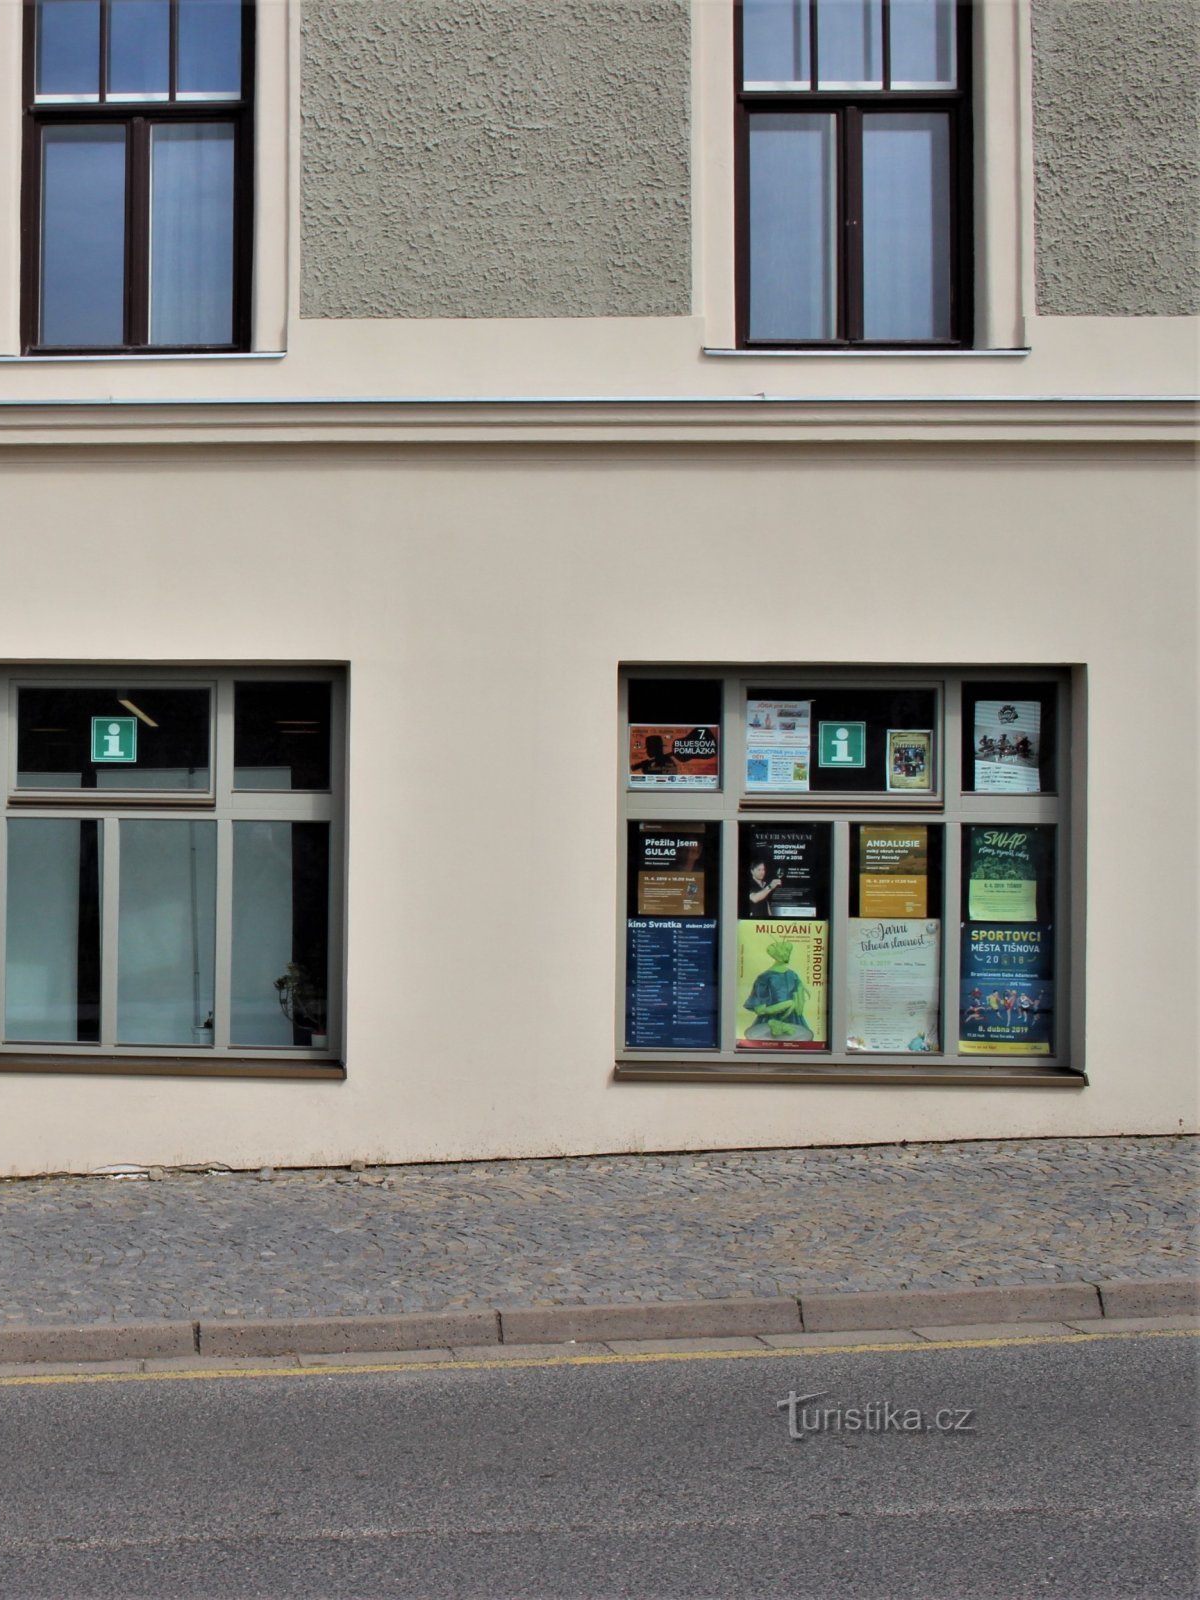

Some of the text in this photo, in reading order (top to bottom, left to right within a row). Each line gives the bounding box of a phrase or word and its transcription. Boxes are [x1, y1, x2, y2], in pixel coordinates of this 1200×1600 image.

[645, 838, 698, 848] Přežila jsem
[866, 839, 920, 848] ANDALUSIE
[983, 831, 1027, 850] SWAP
[645, 848, 677, 856] GULAG
[628, 919, 647, 928] kino
[648, 920, 682, 929] Svratka
[755, 922, 823, 935] MILOVÁNÍ V
[970, 930, 1041, 942] SPORTOVCI
[970, 941, 1040, 953] MĚSTA TIŠNOVA
[812, 937, 825, 987] PŘÍRODĚ
